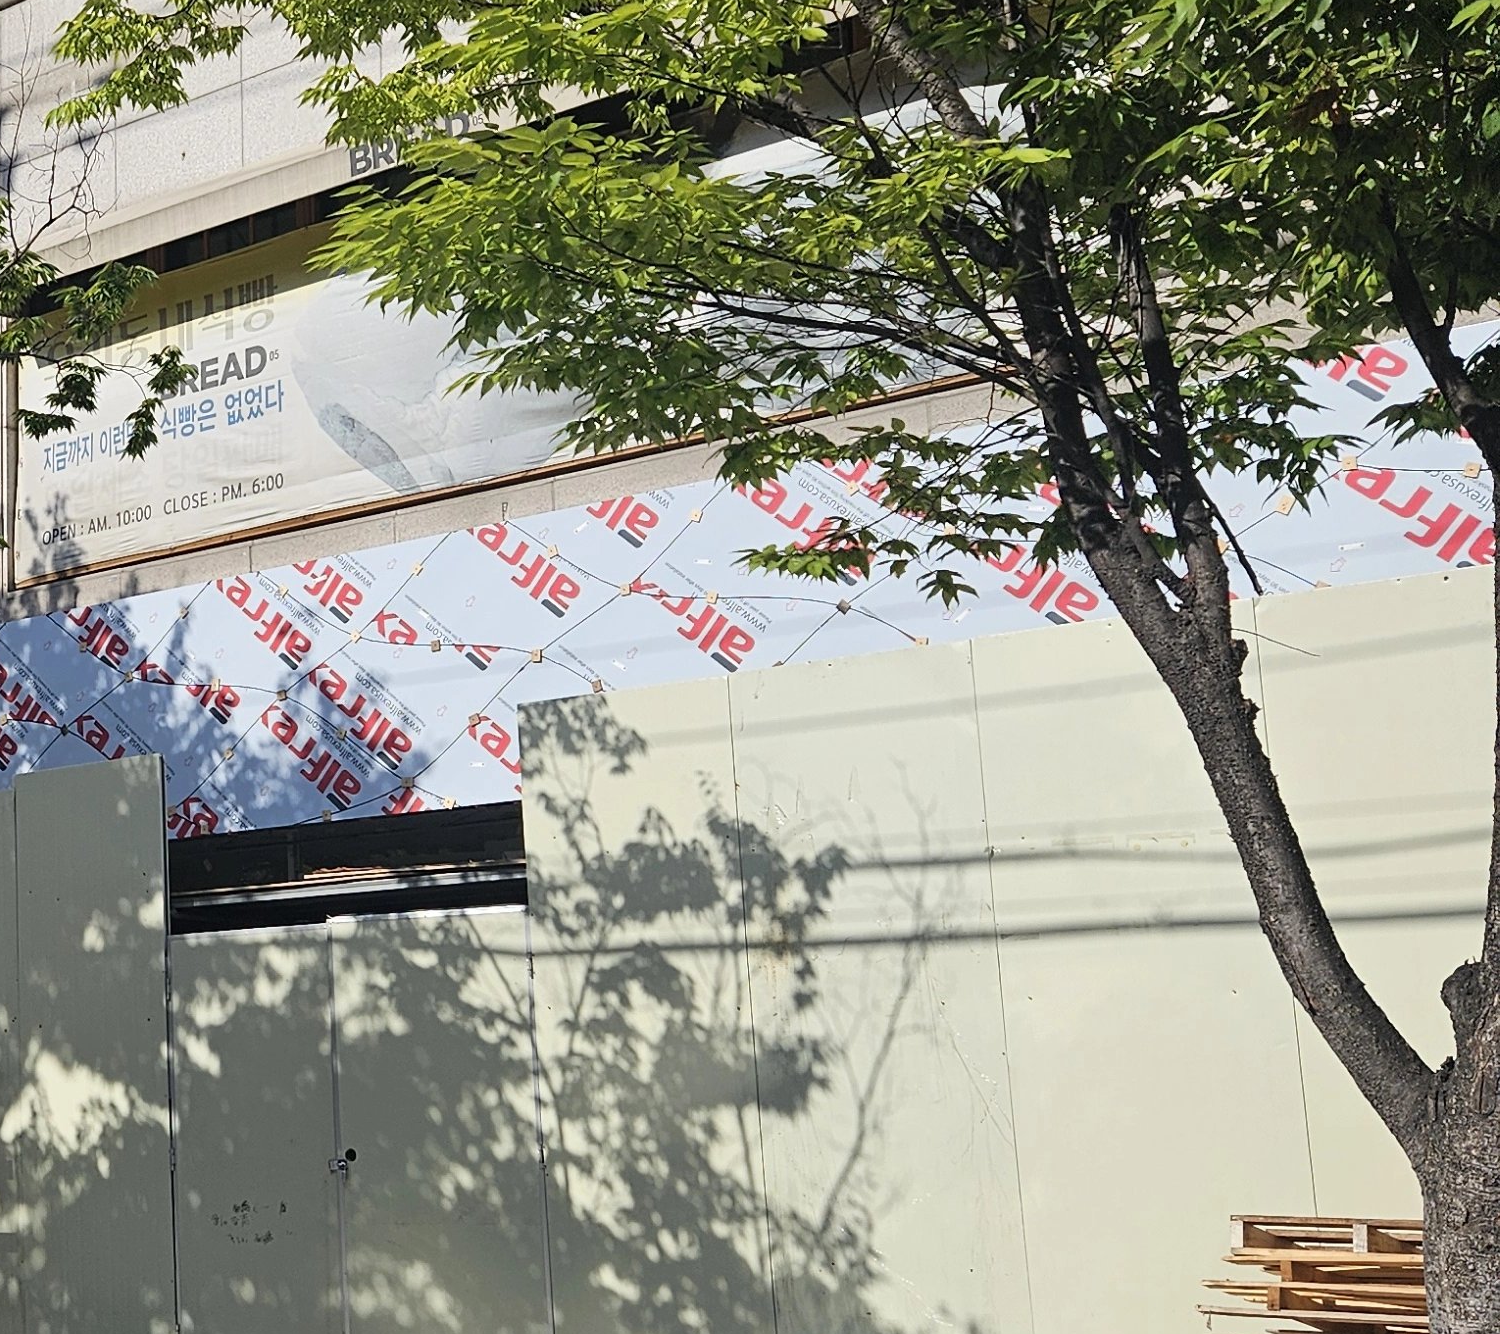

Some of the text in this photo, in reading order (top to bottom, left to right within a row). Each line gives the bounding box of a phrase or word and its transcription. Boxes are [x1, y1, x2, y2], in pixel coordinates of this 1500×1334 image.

[160, 344, 268, 401] READ
[43, 431, 94, 473] 지금까지
[160, 398, 217, 440] 식빵은
[224, 379, 285, 427] 없었다
[42, 523, 77, 546] OPEN
[87, 519, 112, 535] AM.
[116, 505, 152, 528] 10:00
[164, 491, 209, 516] CLOSE
[222, 483, 247, 502] PM.
[252, 473, 284, 495] 6:00
